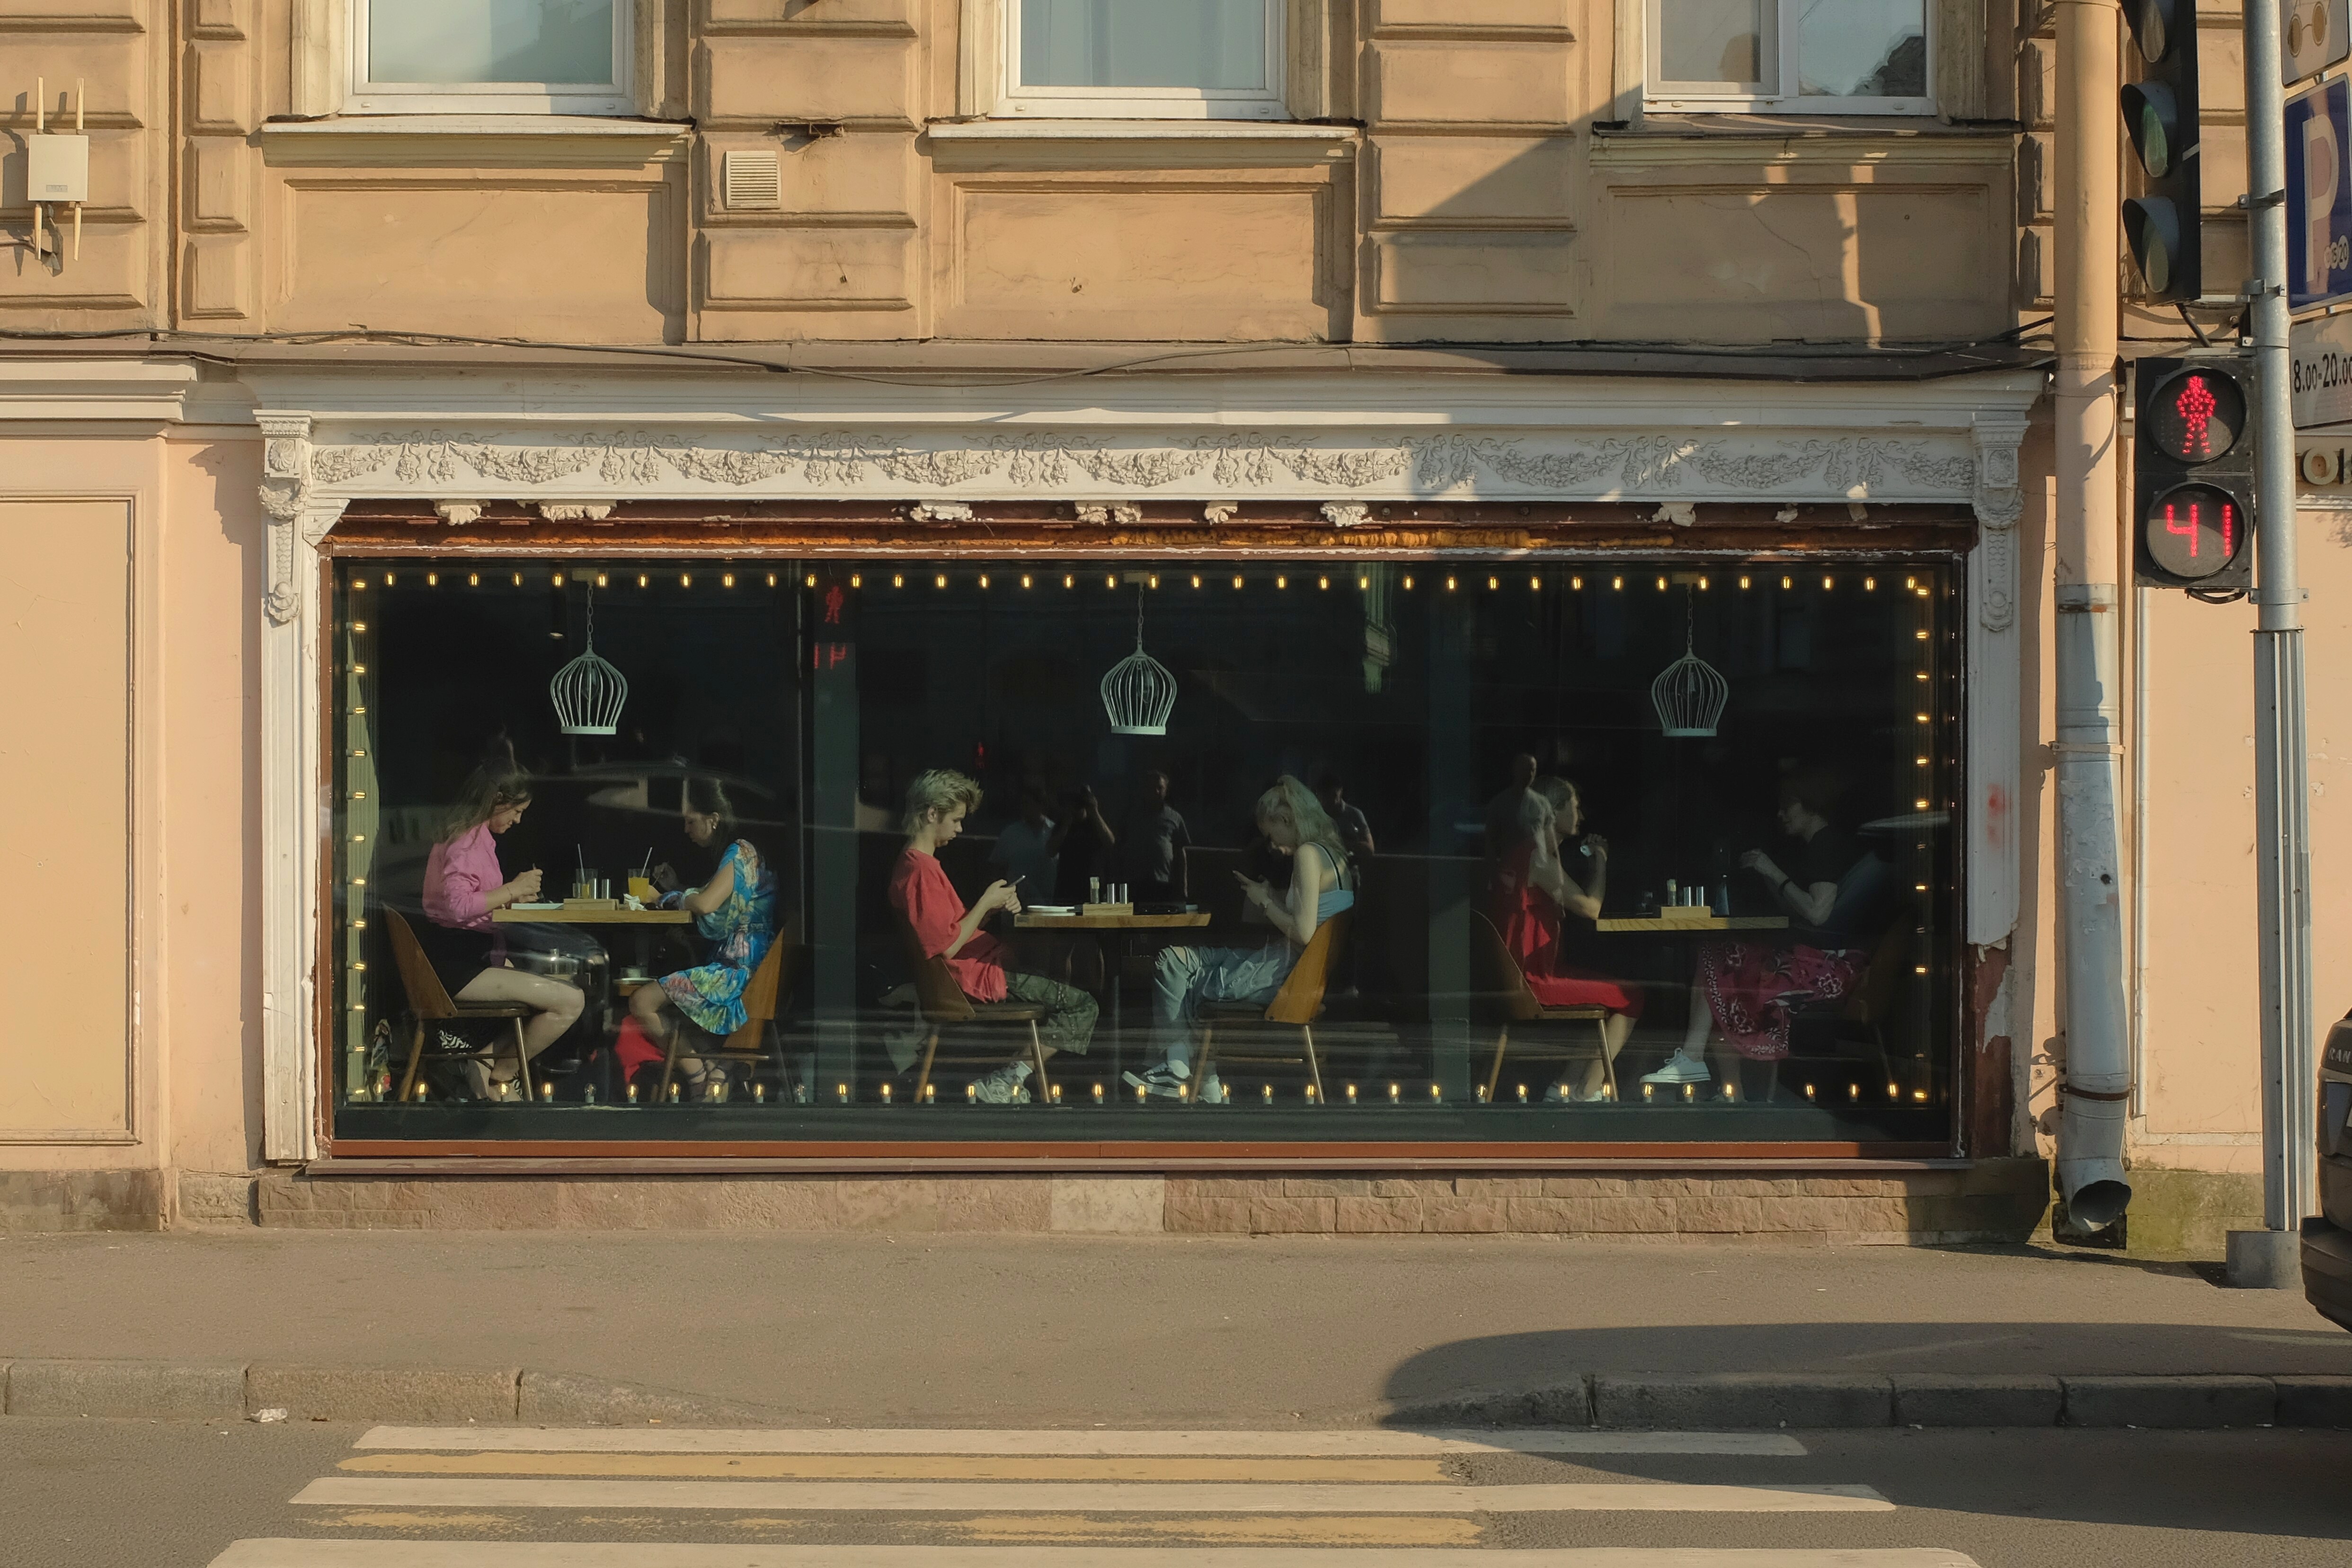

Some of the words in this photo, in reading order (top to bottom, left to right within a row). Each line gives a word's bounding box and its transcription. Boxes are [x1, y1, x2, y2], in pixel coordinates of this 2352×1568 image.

[2303, 114, 2339, 283] P
[2339, 242, 2348, 263] 20
[2166, 504, 2232, 557] 41
